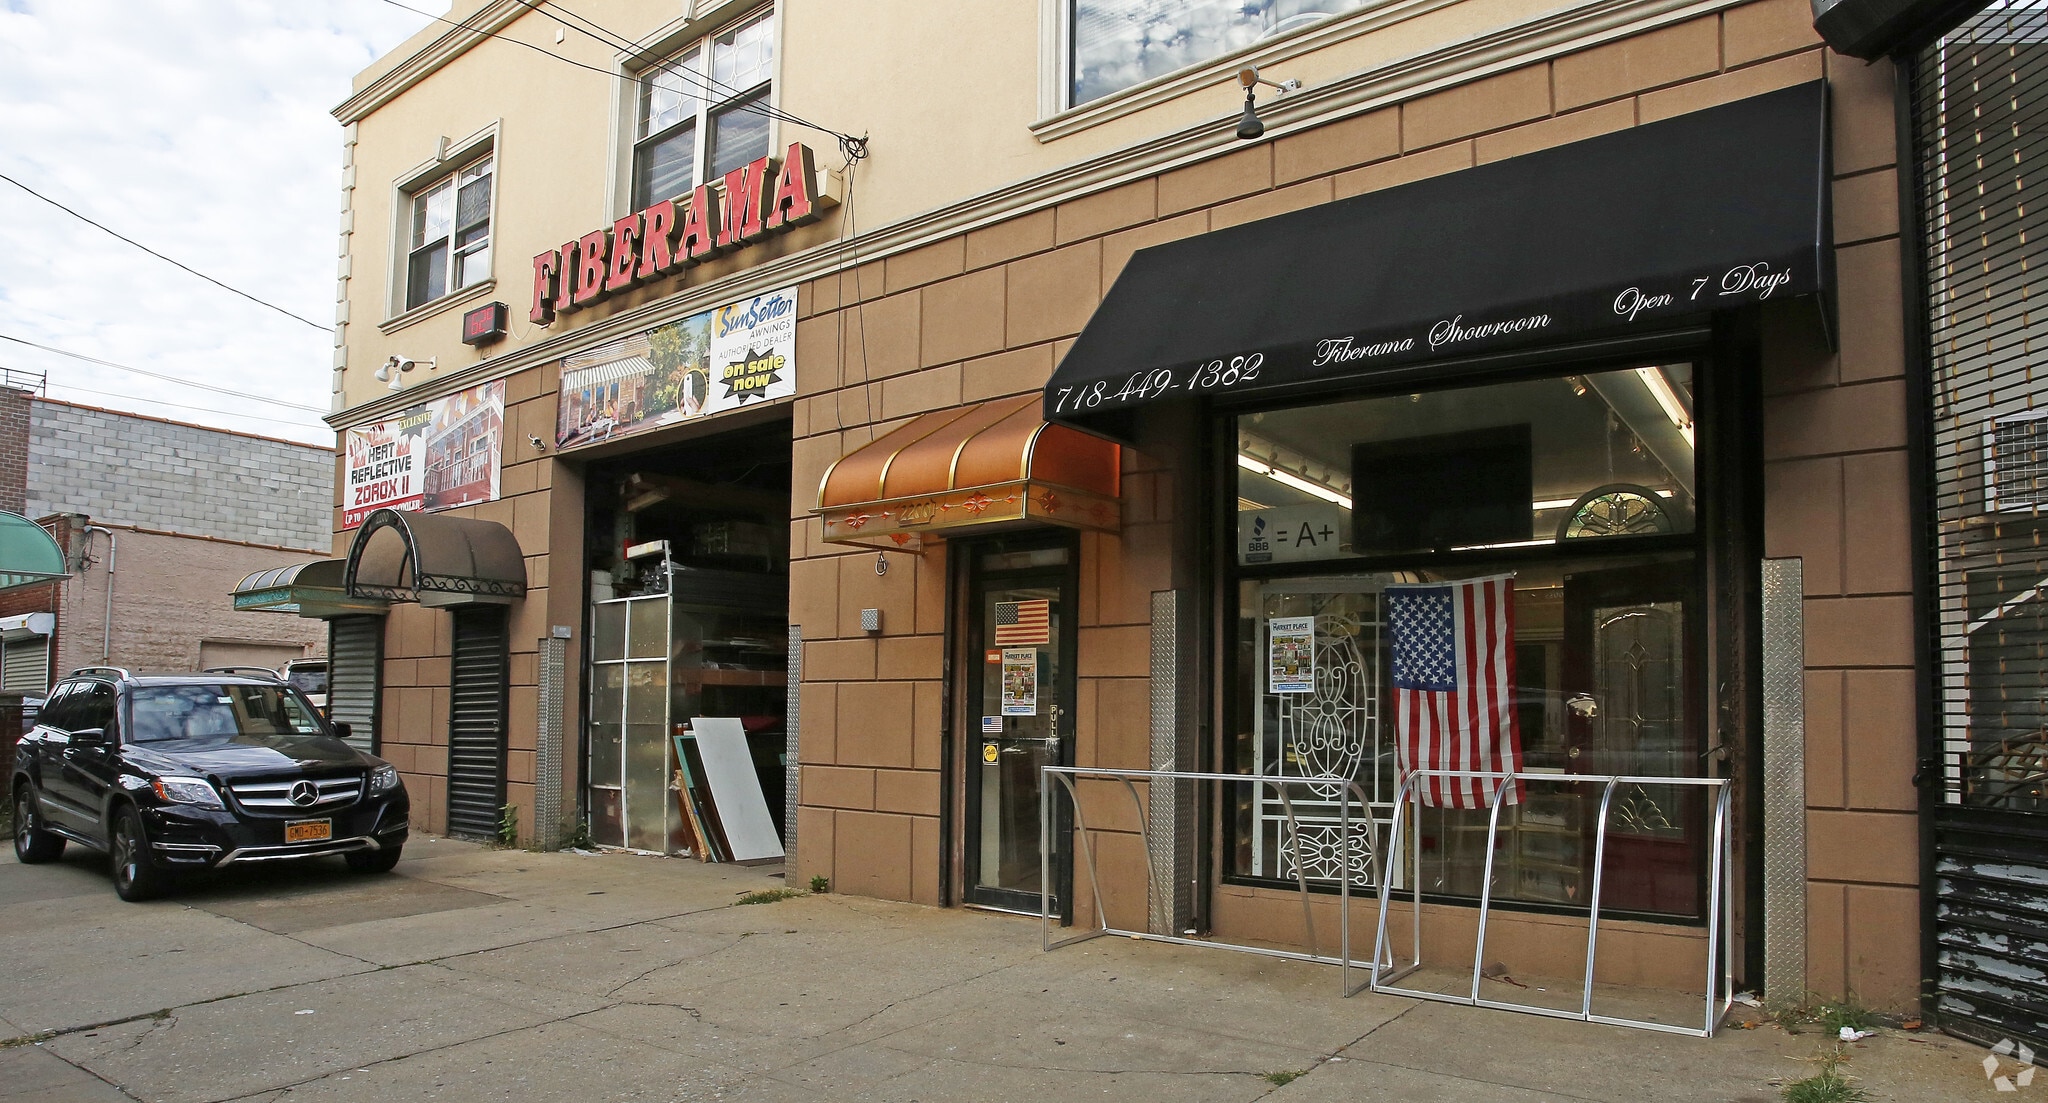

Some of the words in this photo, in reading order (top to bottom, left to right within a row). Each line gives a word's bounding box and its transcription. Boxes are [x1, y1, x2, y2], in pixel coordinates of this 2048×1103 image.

[529, 142, 813, 325] FIBERAMA
[1613, 287, 1674, 321] Open
[1690, 276, 1709, 300] 7
[1719, 262, 1791, 299] Days
[720, 294, 793, 338] SunSetter
[749, 319, 791, 340] AWNINGS
[1312, 335, 1415, 367] Fiberama
[1428, 314, 1552, 352] Showroom
[719, 340, 762, 360] AUTHORIZED
[763, 331, 793, 348] DEALER
[723, 363, 745, 379] on
[747, 354, 785, 375] sale
[733, 373, 771, 392] now
[399, 410, 432, 431] EXCLUSIVE
[368, 442, 395, 463] HEAT
[351, 455, 412, 485] REFLECTIVE
[354, 478, 398, 506] ZOROX
[345, 511, 353, 525] UP
[354, 512, 361, 523] TO
[900, 503, 931, 521] 2200
[1248, 541, 1269, 552] BBB
[1295, 521, 1334, 548] A+
[1293, 622, 1308, 630] PLACE
